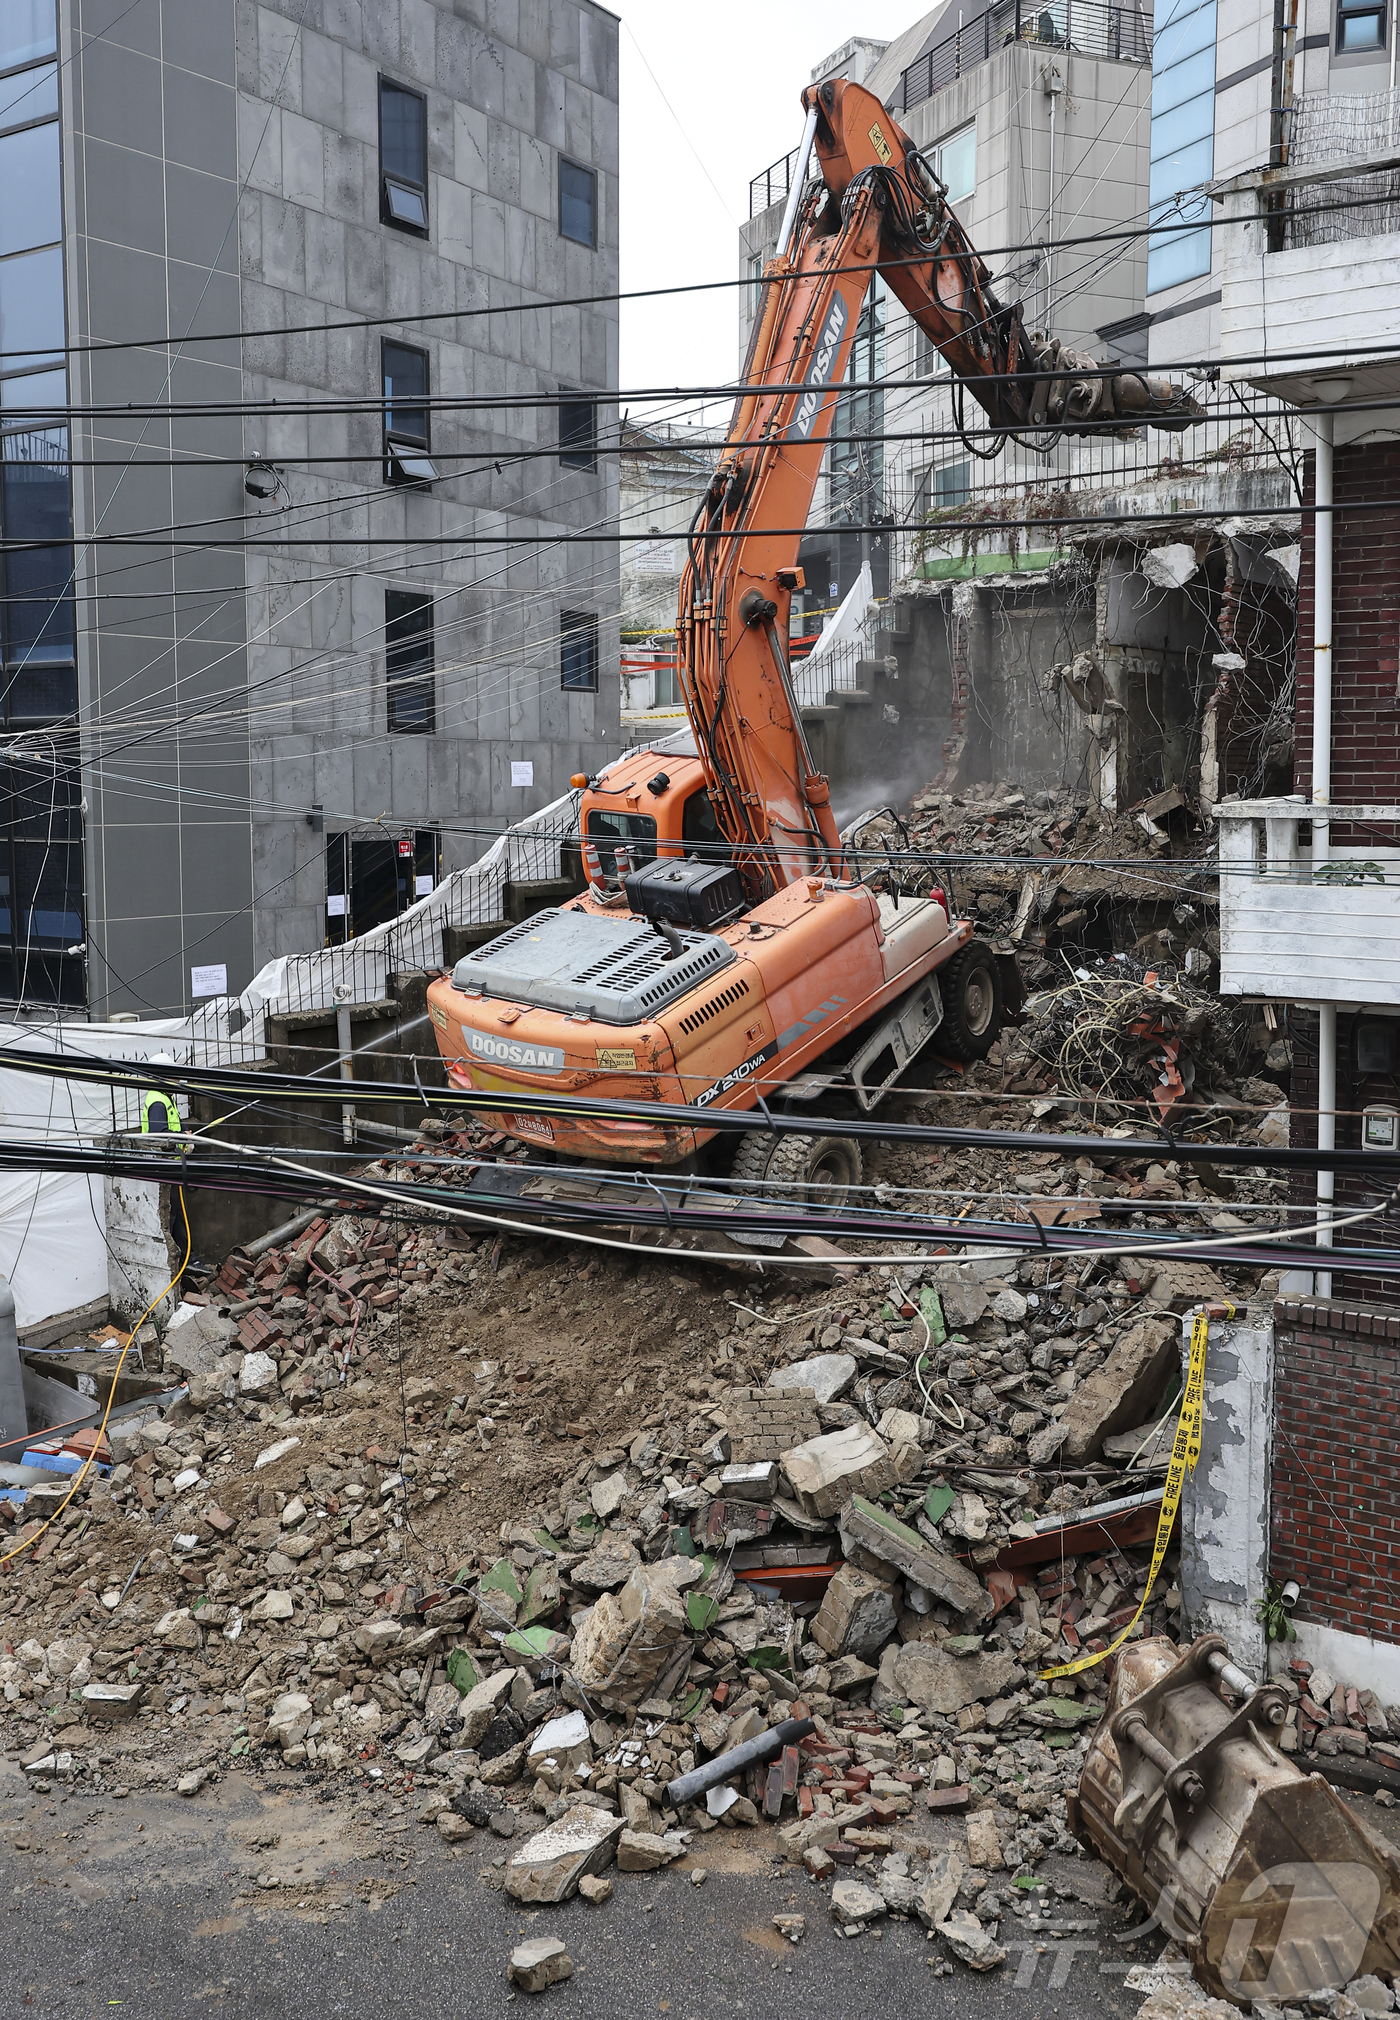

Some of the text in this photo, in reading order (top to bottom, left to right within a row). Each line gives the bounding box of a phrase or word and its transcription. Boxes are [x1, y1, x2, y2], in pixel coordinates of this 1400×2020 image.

[796, 303, 844, 436] DOOSAN
[472, 1034, 554, 1066] DOOSAN
[1173, 1428, 1190, 1461] 출입통제
[1166, 1464, 1182, 1500] FIRE LINE
[1155, 1524, 1170, 1554] 출입통제
